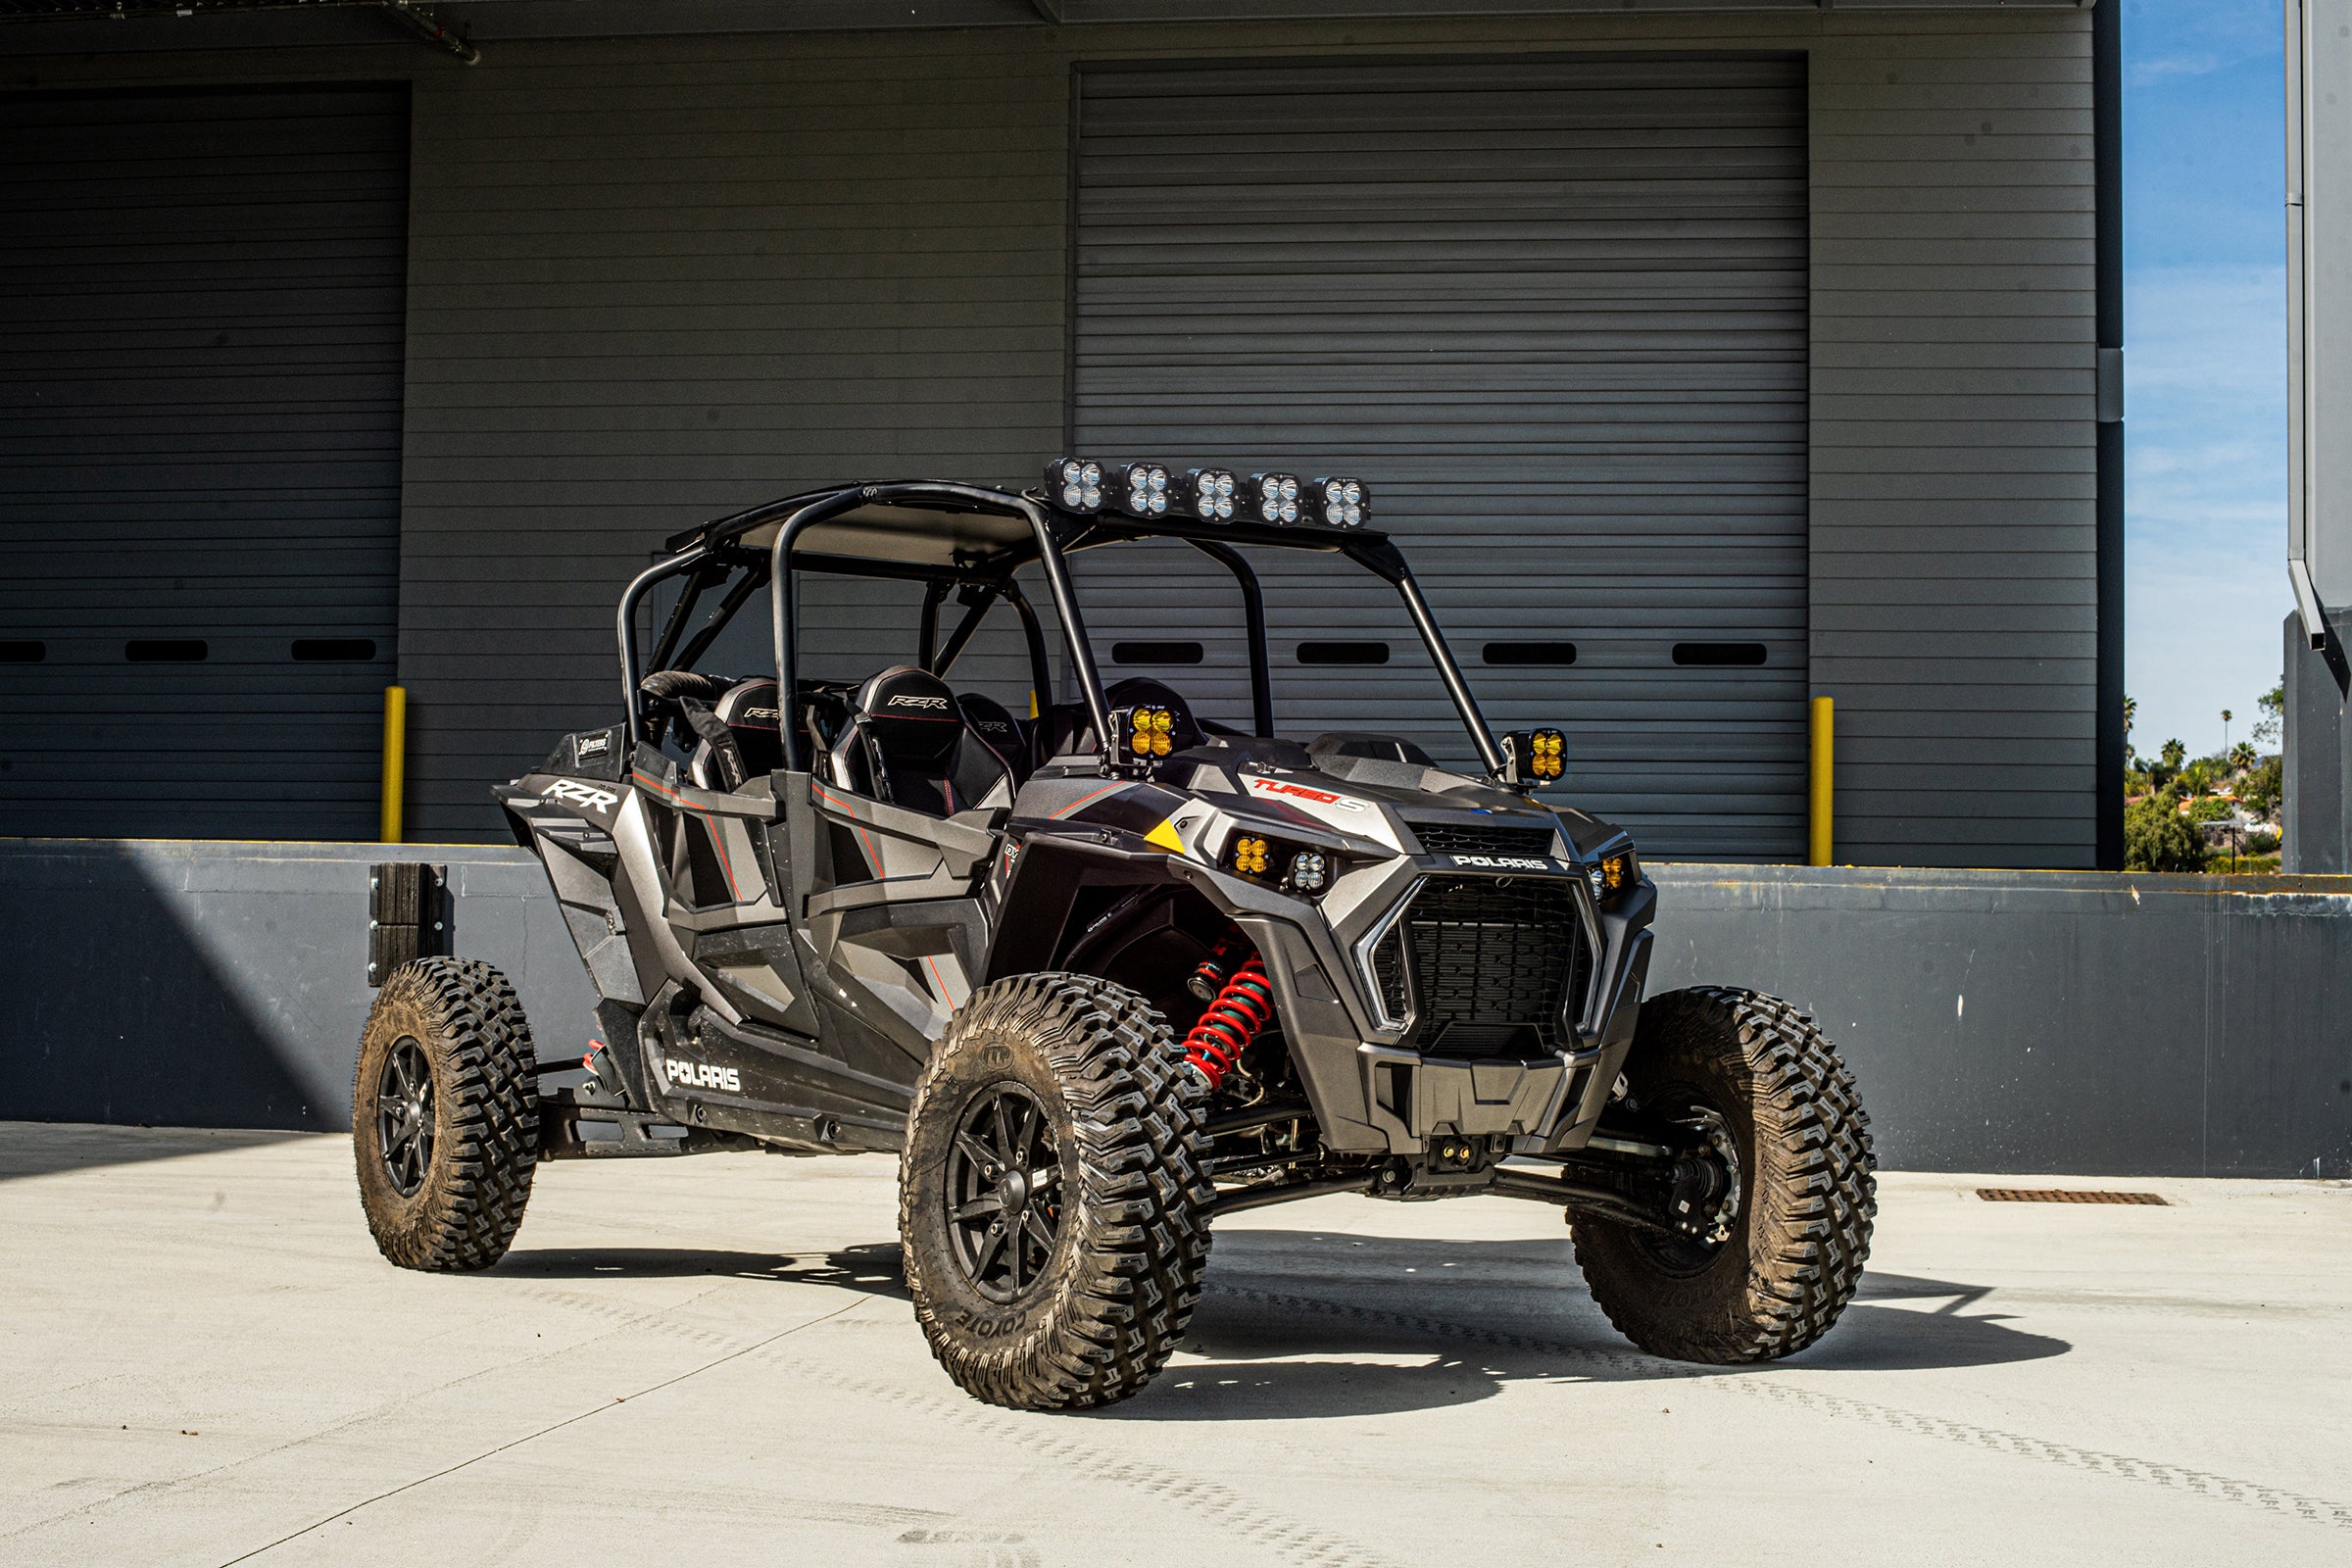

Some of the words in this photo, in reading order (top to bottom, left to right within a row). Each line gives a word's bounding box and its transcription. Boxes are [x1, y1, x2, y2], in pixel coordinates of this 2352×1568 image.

[888, 695, 948, 710] RZR
[744, 708, 779, 720] RZ
[979, 721, 1007, 733] ZR
[541, 778, 618, 814] RZR
[1254, 779, 1342, 804] TURBO
[1334, 798, 1371, 812] S
[1450, 856, 1548, 870] POLARIS
[983, 1045, 1011, 1065] ITP
[666, 1059, 741, 1092] POLARIS
[955, 1308, 1027, 1338] COYOTE
